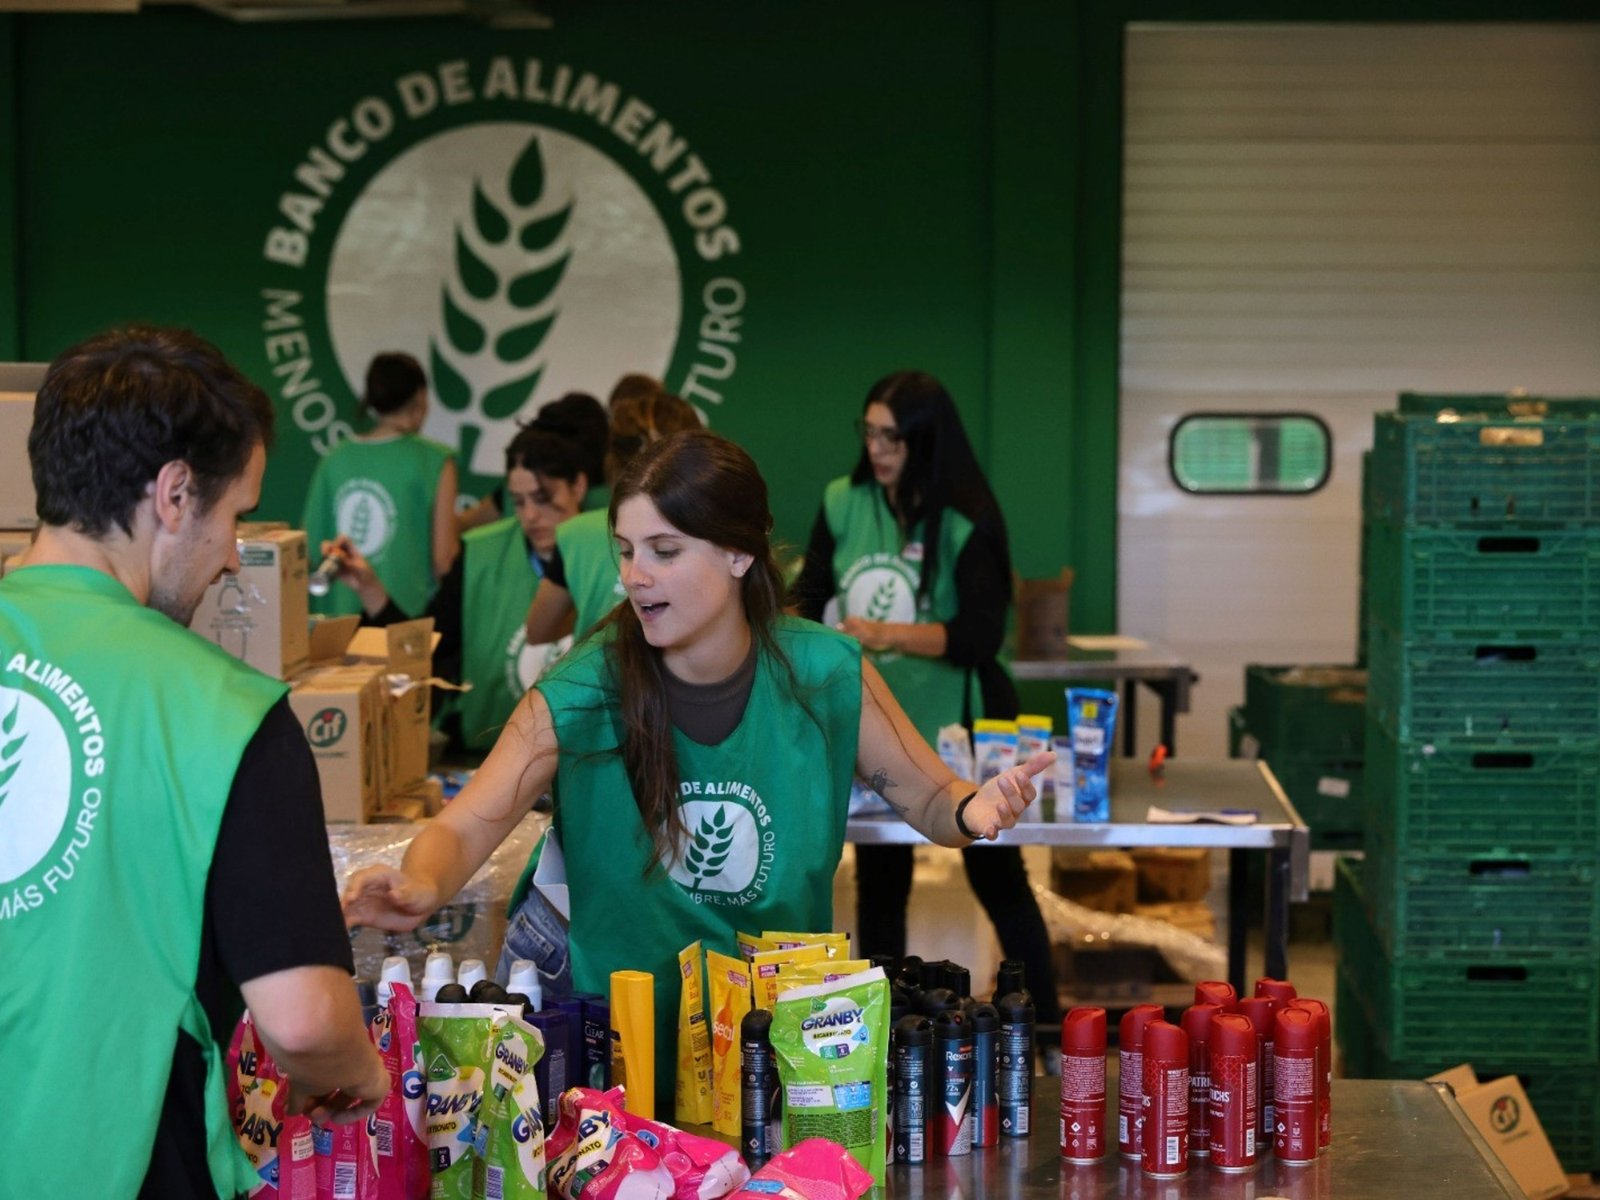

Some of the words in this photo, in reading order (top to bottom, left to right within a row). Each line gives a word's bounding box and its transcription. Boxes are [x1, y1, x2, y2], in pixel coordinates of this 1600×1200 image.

[264, 96, 395, 267] BANCO
[396, 60, 475, 119] DE
[483, 57, 741, 261] ALIMENTOS
[679, 277, 747, 427] TURO
[6, 653, 106, 778] ALIMENTOS
[42, 787, 102, 894] FUTURO
[680, 781, 702, 796] DE
[704, 781, 771, 827] ALIMENTOS
[726, 890, 758, 907] MÁS
[754, 830, 775, 892] FUTURO
[801, 1008, 864, 1031] GRANBY
[1188, 1076, 1210, 1088] PATRI
